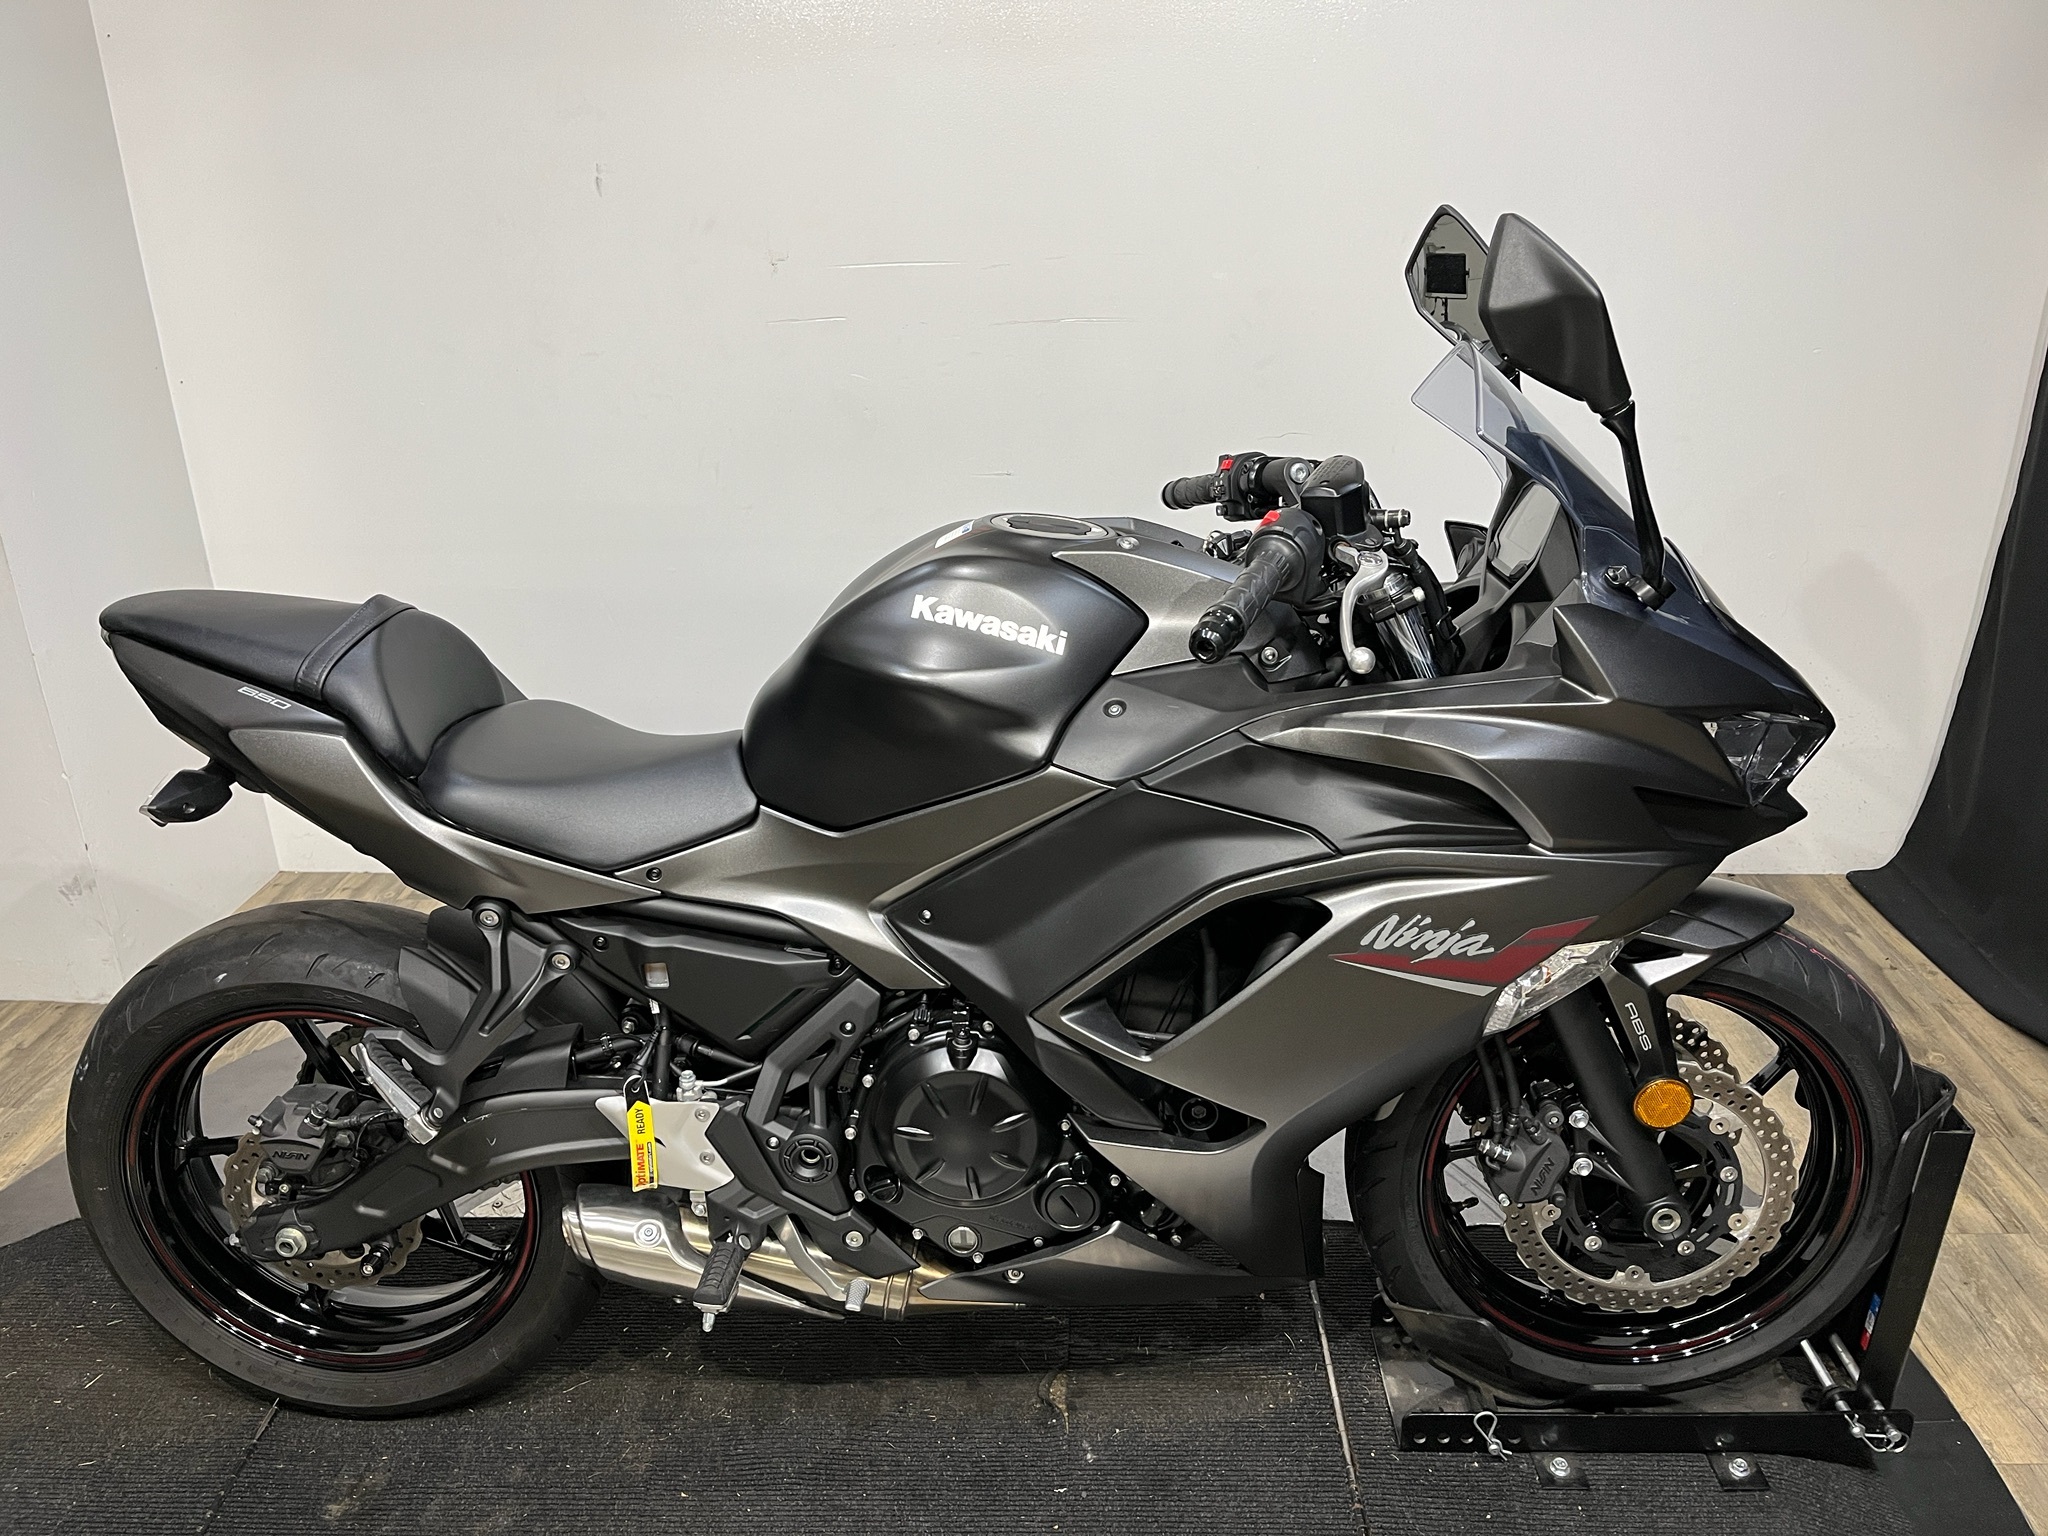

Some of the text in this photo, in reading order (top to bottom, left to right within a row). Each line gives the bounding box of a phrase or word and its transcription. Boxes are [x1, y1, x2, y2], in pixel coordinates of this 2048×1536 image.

[910, 594, 1068, 656] Kawasaki
[237, 686, 292, 710] 650
[1360, 913, 1495, 964] Ninja
[1624, 1002, 1652, 1051] ABS
[634, 1108, 646, 1135] READY
